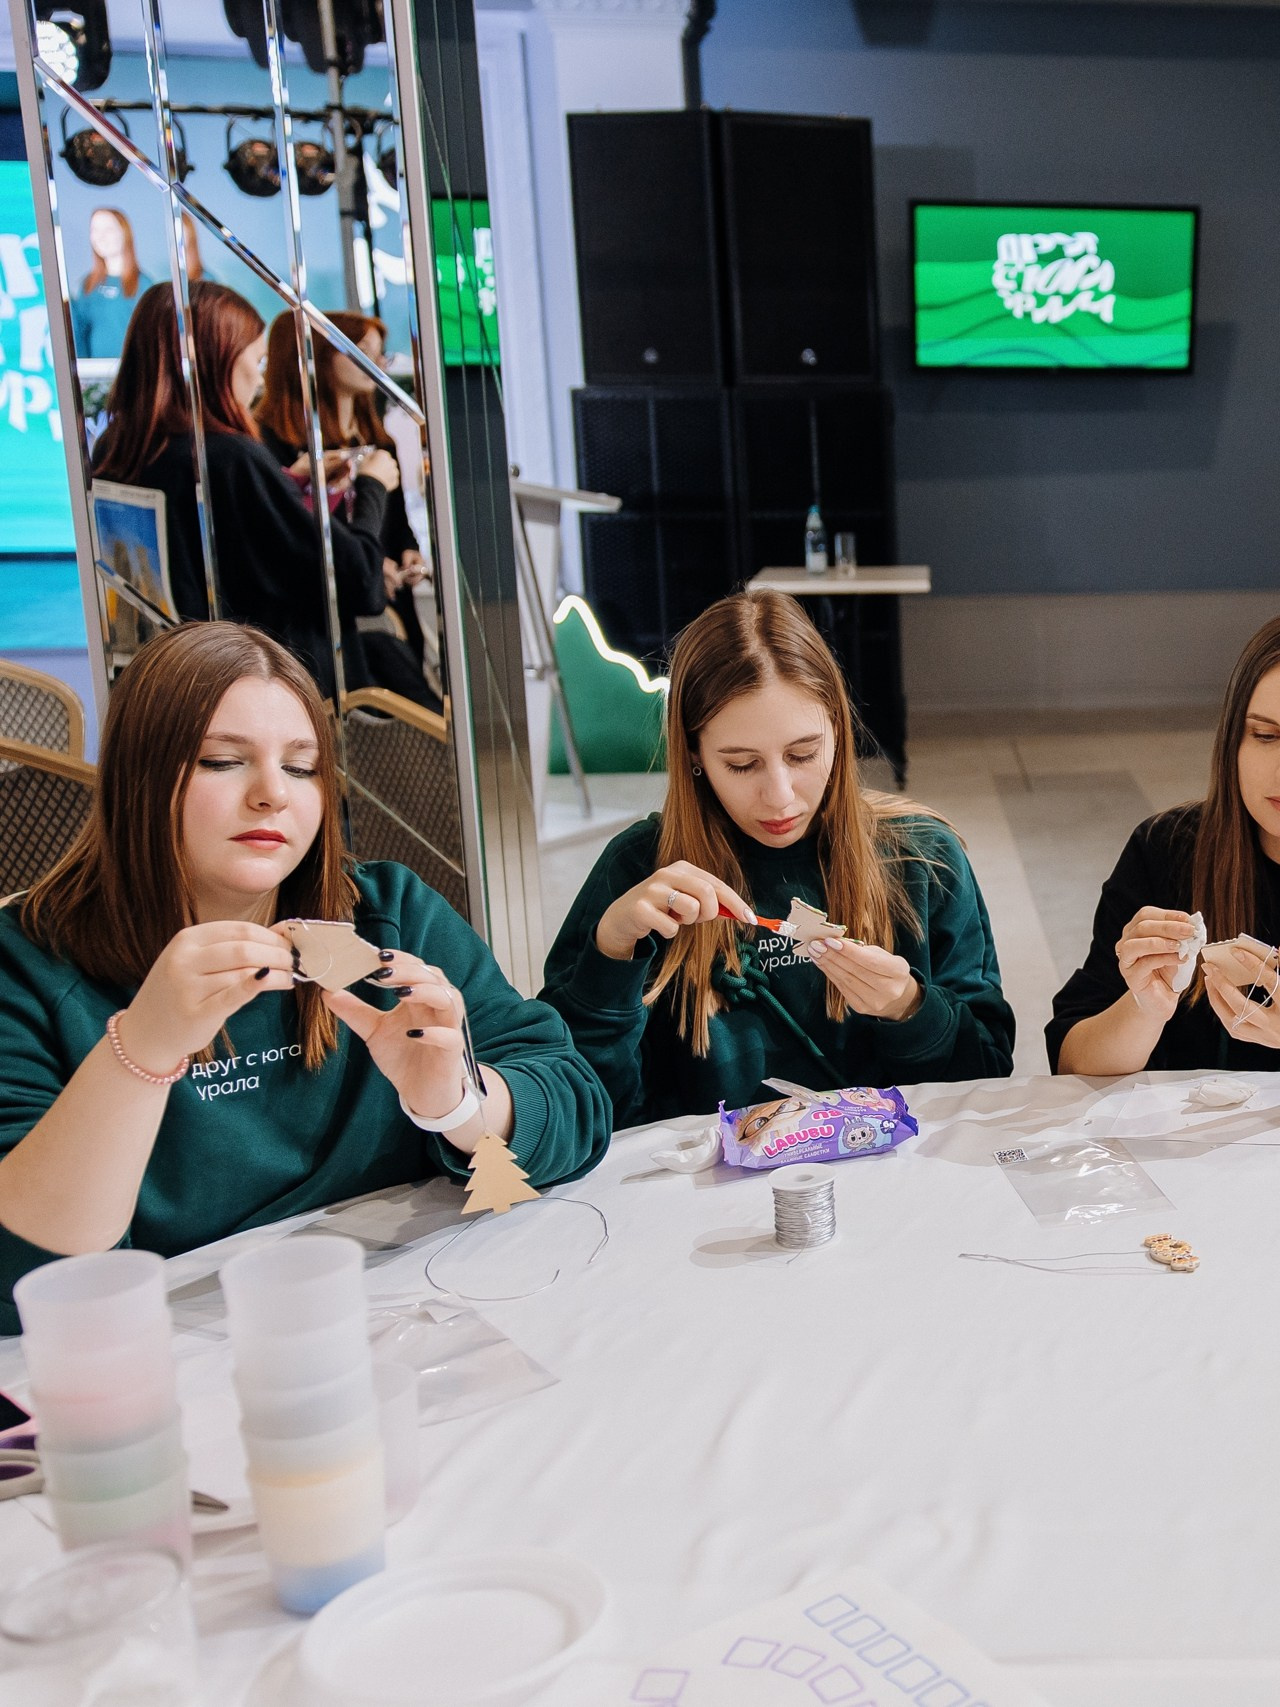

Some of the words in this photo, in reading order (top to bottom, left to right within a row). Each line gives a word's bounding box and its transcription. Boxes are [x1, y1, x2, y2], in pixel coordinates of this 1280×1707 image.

[191, 1056, 242, 1080] друг
[245, 1052, 258, 1067] с
[261, 1043, 302, 1065] юга
[195, 1074, 260, 1102] урала
[763, 1125, 835, 1158] LABUBU
